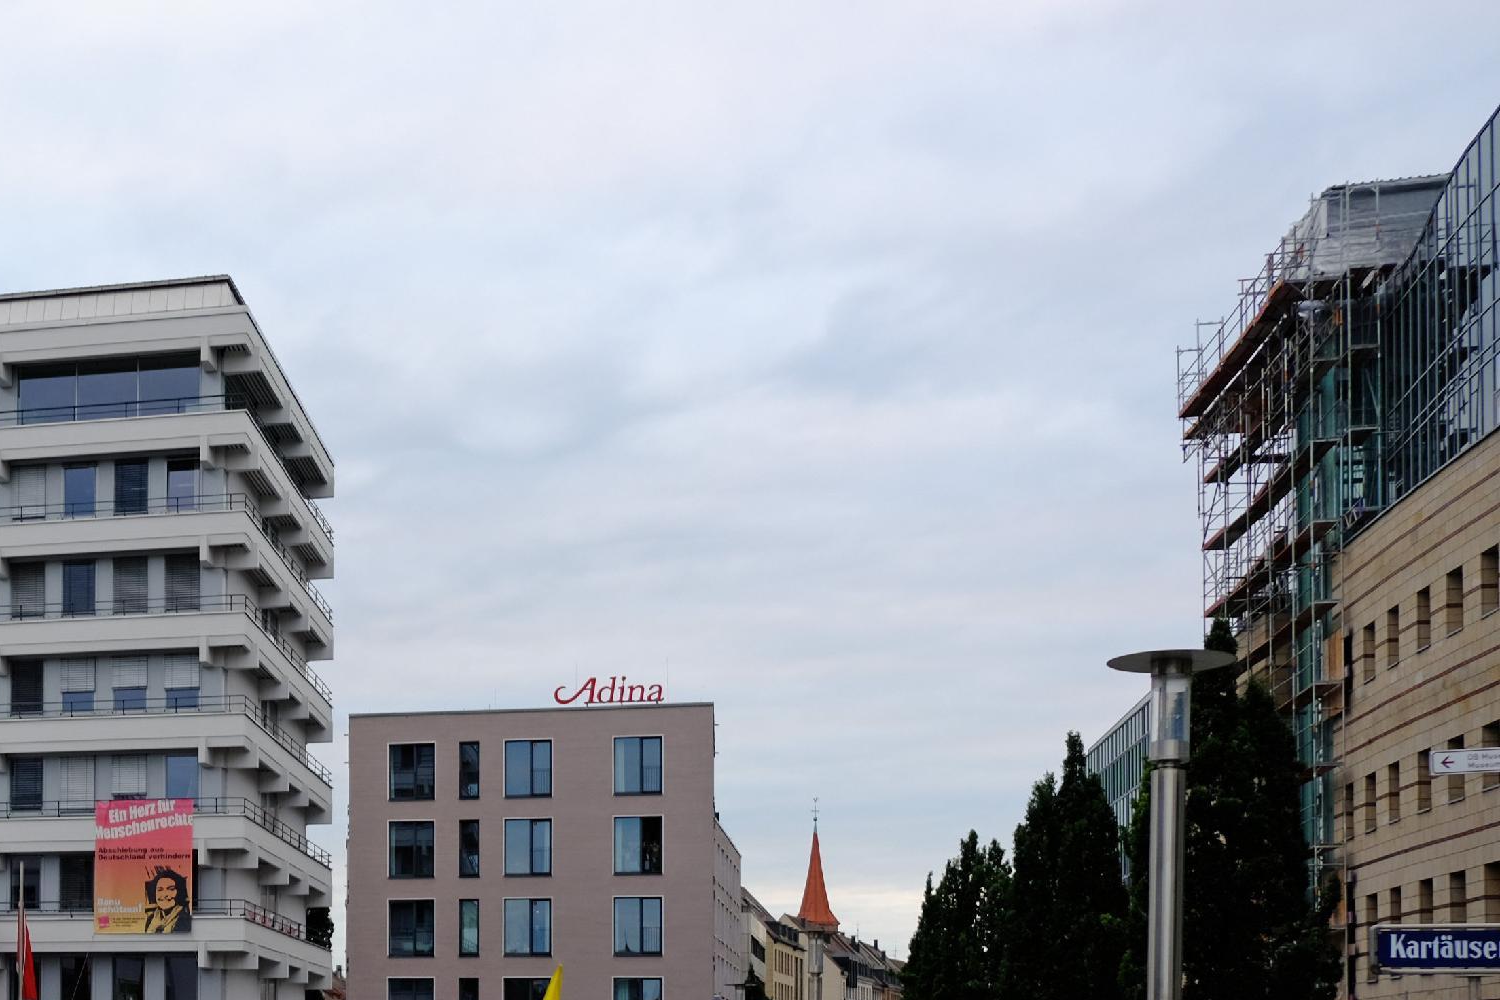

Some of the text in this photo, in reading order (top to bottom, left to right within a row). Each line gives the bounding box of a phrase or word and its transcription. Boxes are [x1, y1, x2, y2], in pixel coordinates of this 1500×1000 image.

[553, 676, 664, 704] Adina
[108, 799, 176, 823] Ein Herz für
